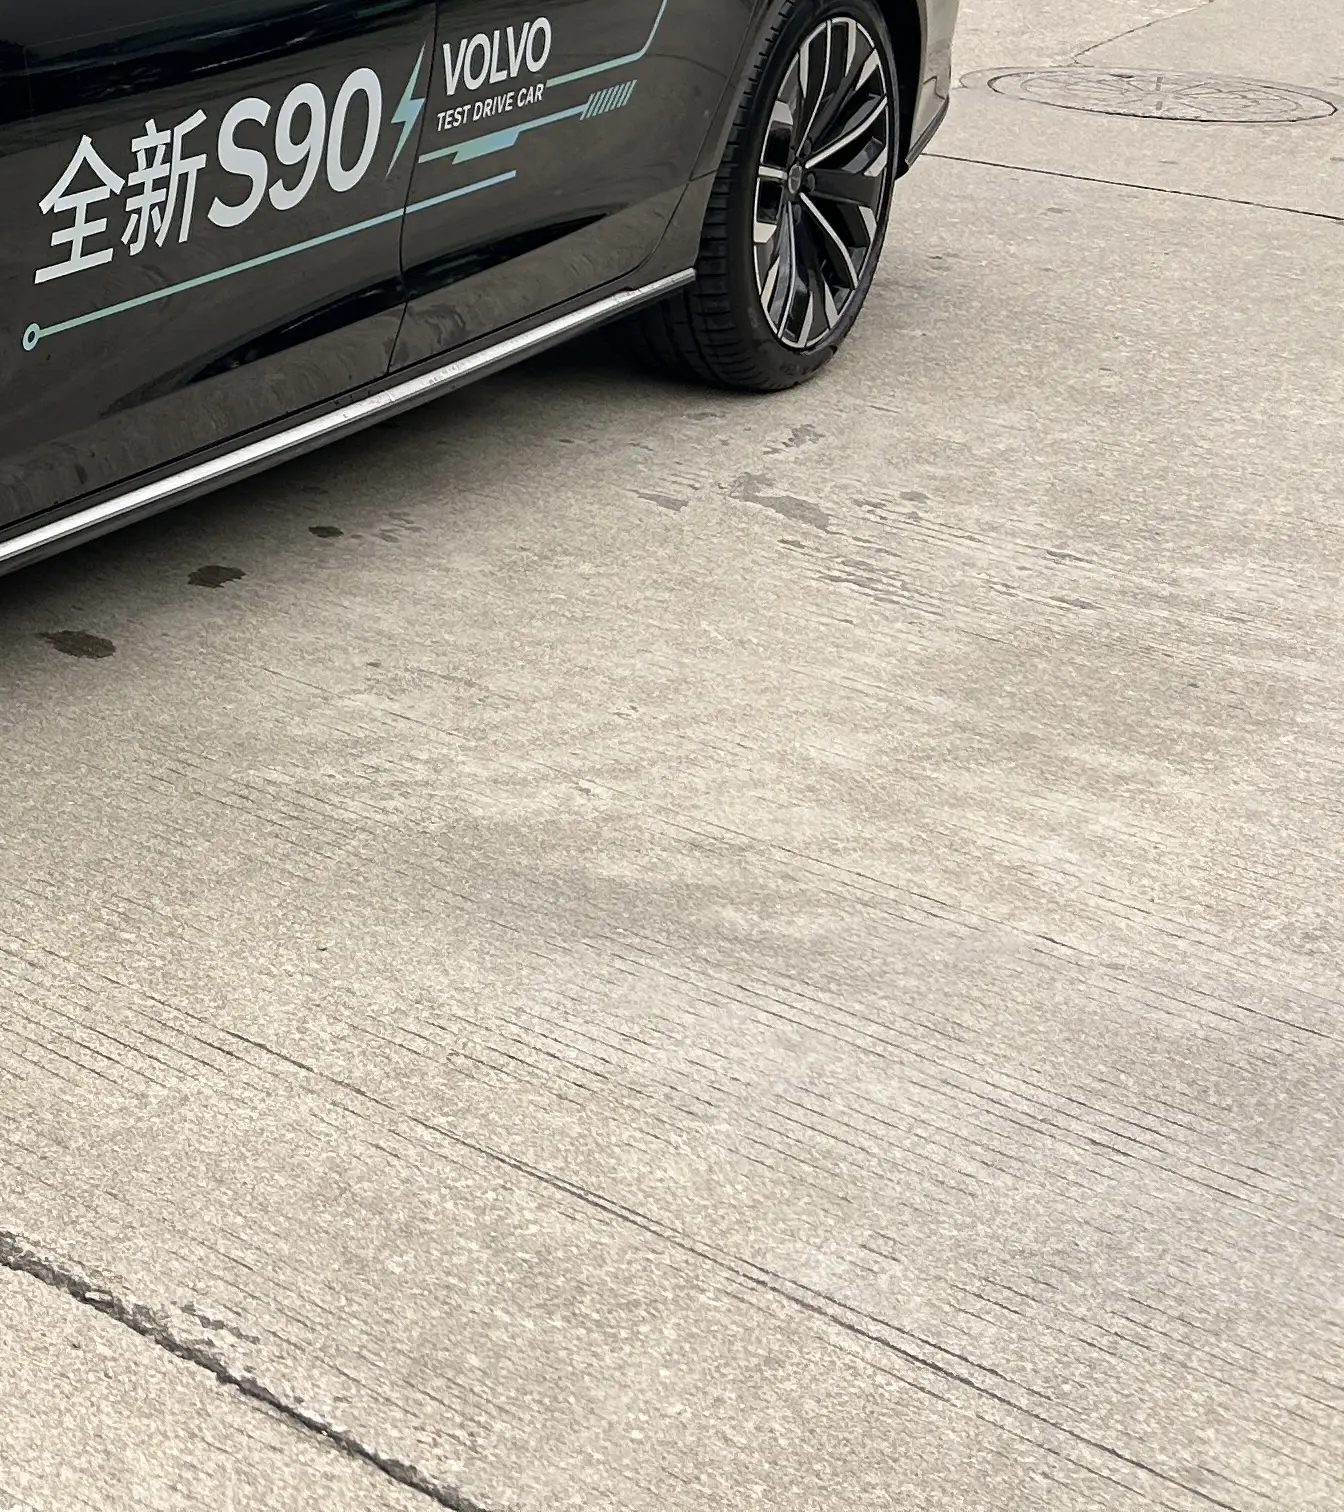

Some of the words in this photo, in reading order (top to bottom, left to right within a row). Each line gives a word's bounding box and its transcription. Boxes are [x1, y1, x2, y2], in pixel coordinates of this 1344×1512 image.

[442, 16, 552, 96] VOLVO
[436, 104, 472, 132] TEST
[472, 91, 515, 122] DRIVE
[516, 83, 545, 108] CAR
